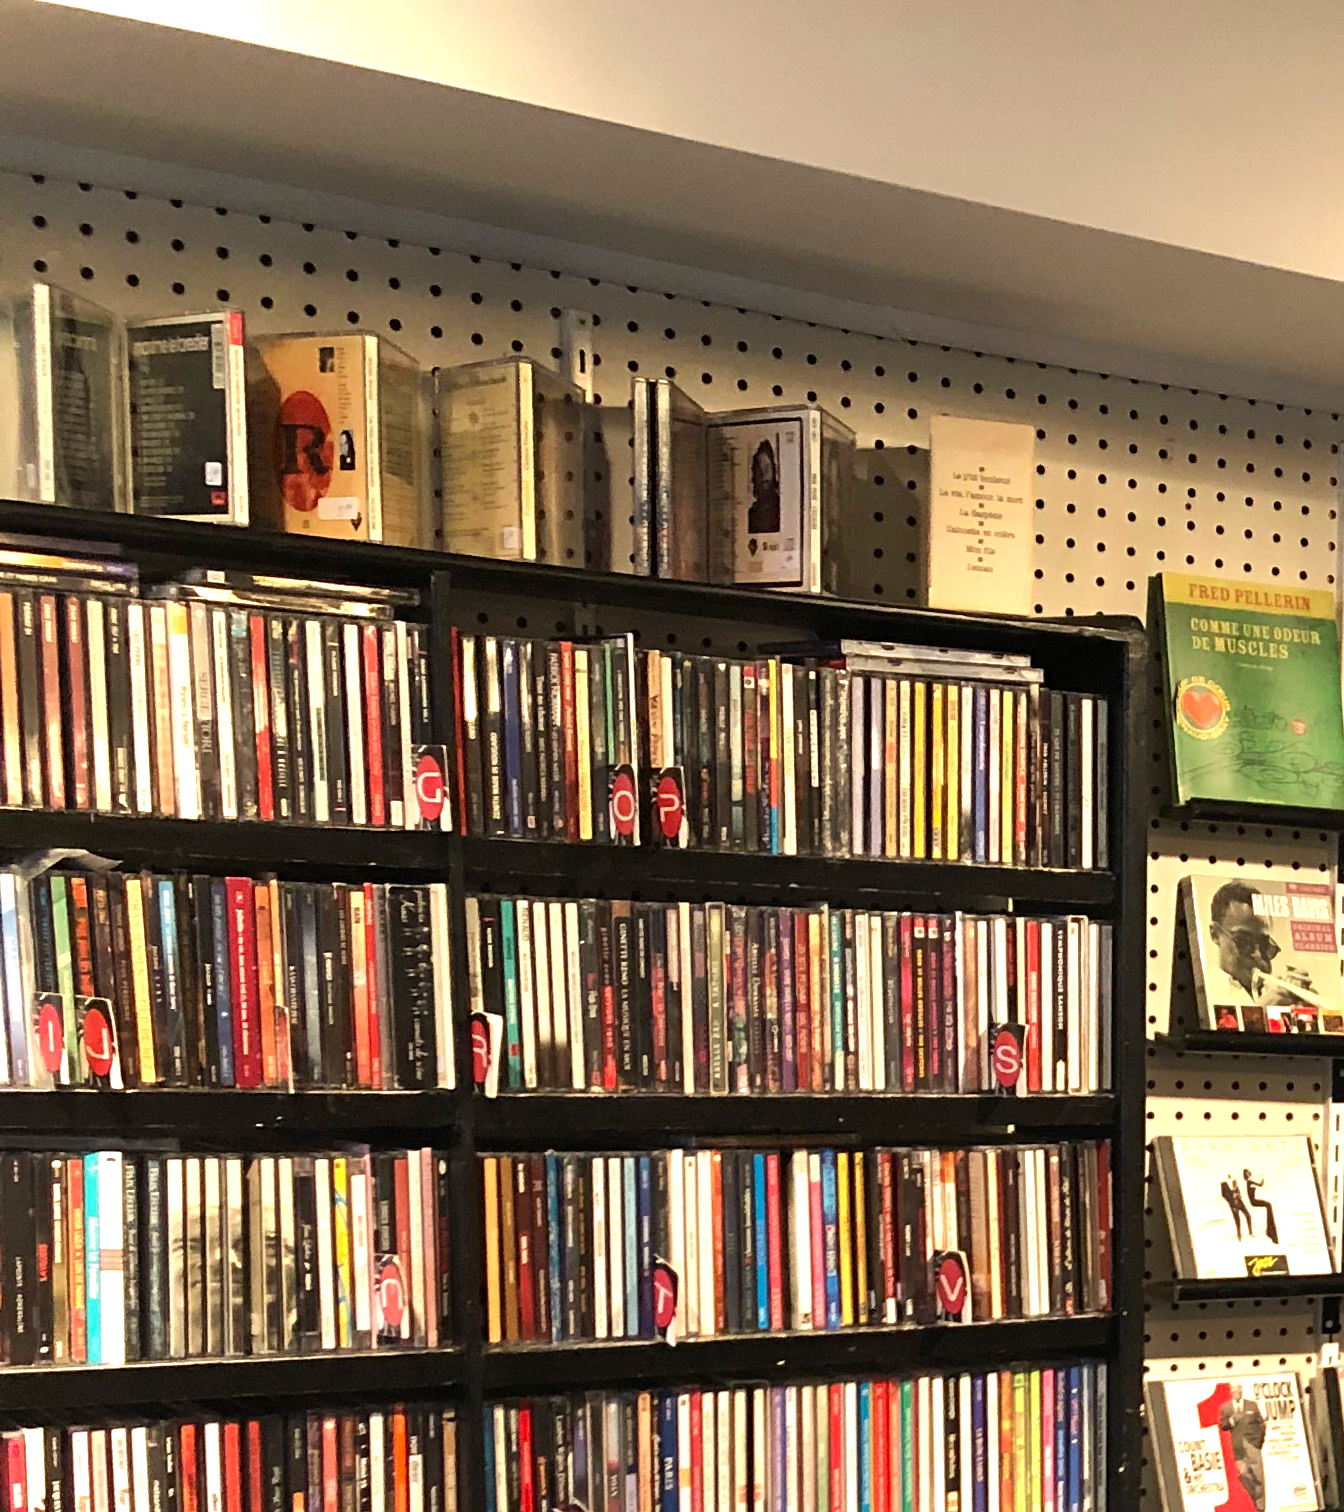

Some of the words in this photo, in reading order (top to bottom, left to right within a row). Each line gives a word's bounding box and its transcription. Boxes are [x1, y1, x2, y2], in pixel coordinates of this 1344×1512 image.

[1188, 584, 1230, 603] FRED
[1234, 588, 1311, 610] PELLERIN
[1190, 617, 1240, 636] COMME
[1242, 623, 1270, 639] UNE
[1273, 629, 1320, 646] ODEUR
[1191, 635, 1210, 651] DE
[1214, 637, 1289, 659] MUSCLES
[549, 653, 559, 684] PATRICK
[551, 685, 561, 726] NORMAN
[417, 772, 441, 803] G
[613, 790, 635, 821] O
[659, 793, 680, 822] P
[1251, 893, 1291, 918] MILES
[1291, 896, 1332, 920] DAVIS
[619, 923, 628, 960] GINETTE
[1293, 932, 1334, 943] ALBUM
[620, 962, 629, 985] RENO
[85, 1027, 110, 1059] J
[623, 1040, 631, 1050] EN
[995, 1045, 1019, 1074] S
[654, 1281, 673, 1314] T
[940, 1274, 963, 1302] V
[1253, 1381, 1293, 1402] O'CLOCK
[1265, 1400, 1296, 1422] JUMP
[1178, 1440, 1206, 1454] COUNT
[1190, 1452, 1223, 1472] BASIE
[1184, 1468, 1191, 1484] &
